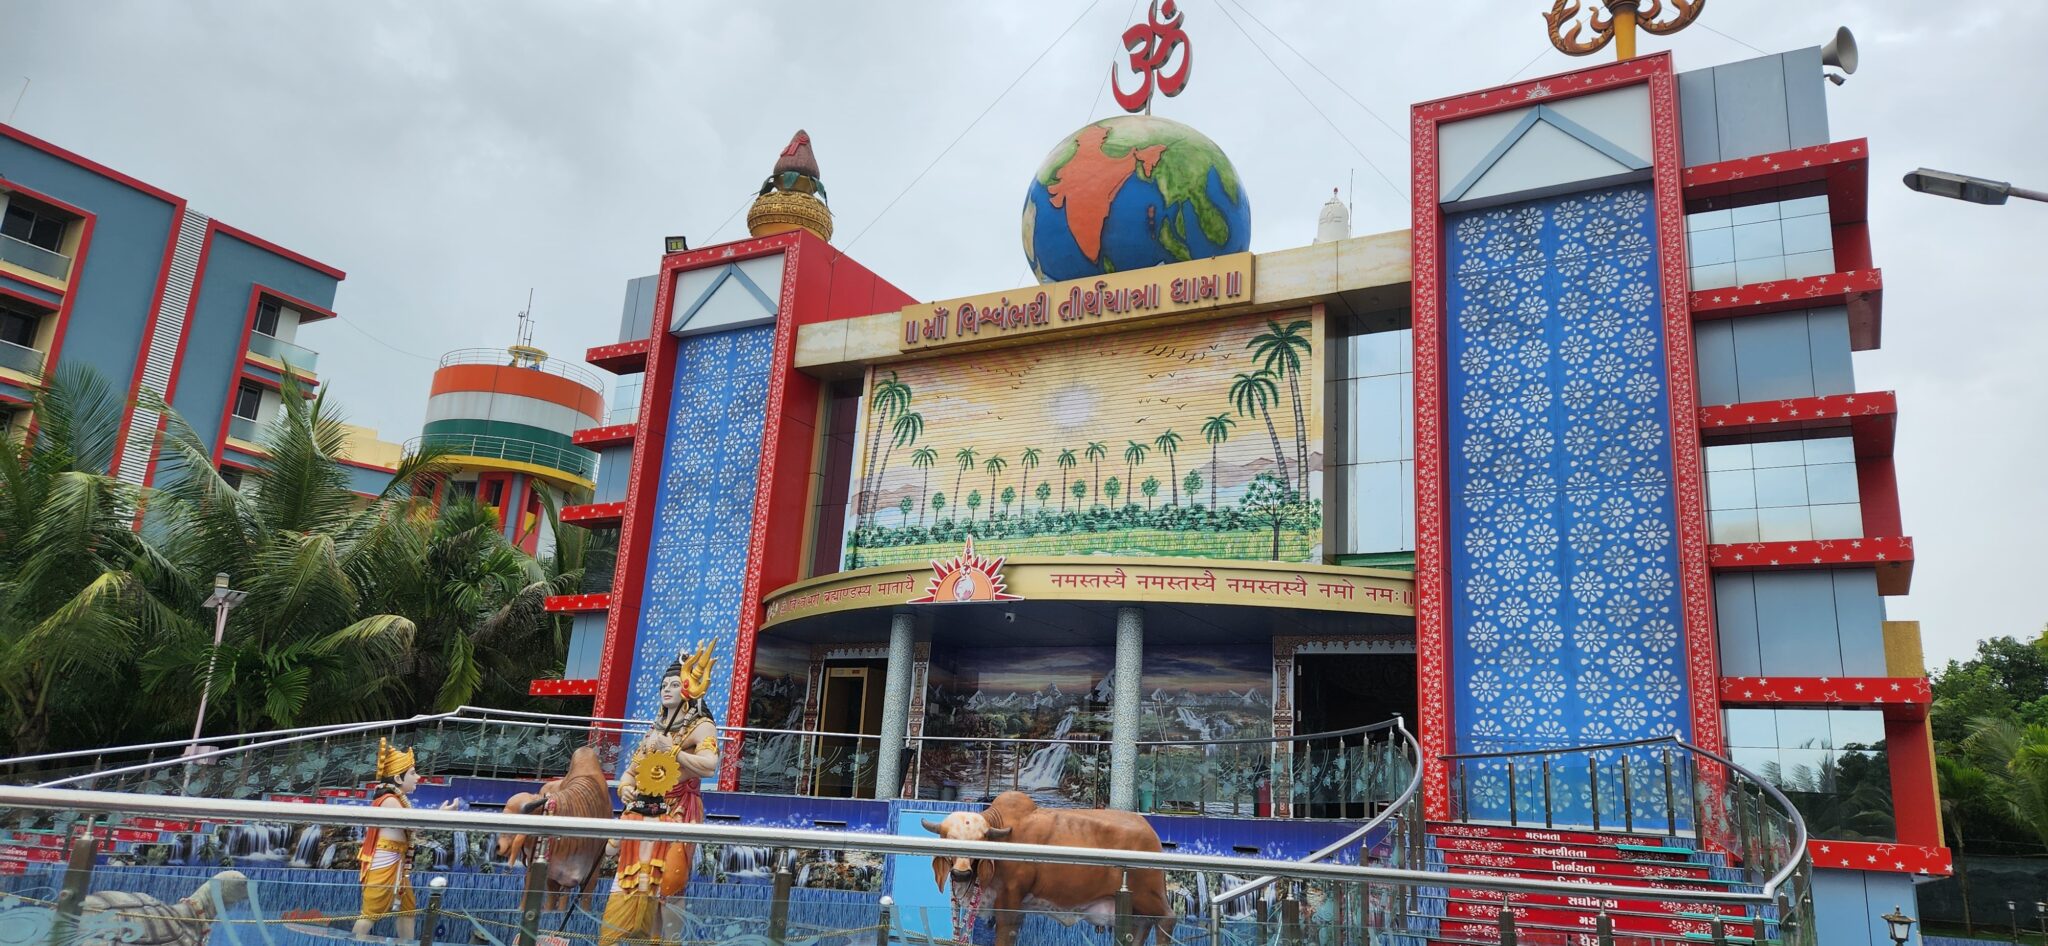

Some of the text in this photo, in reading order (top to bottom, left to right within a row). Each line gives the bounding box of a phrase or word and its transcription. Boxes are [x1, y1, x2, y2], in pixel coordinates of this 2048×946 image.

[1058, 280, 1159, 321] તીર્થયાત્રા
[1170, 274, 1220, 304] ધામ
[877, 574, 915, 595] मातायै
[1050, 568, 1128, 589] नमस्तस्यै
[1135, 569, 1217, 592] नमस्तस्यै
[1226, 575, 1308, 597] नमस्तस्यै
[1317, 579, 1355, 600] नमो
[1532, 846, 1587, 858] સહનશીલતા
[1552, 860, 1596, 873] નિર્ભયતા
